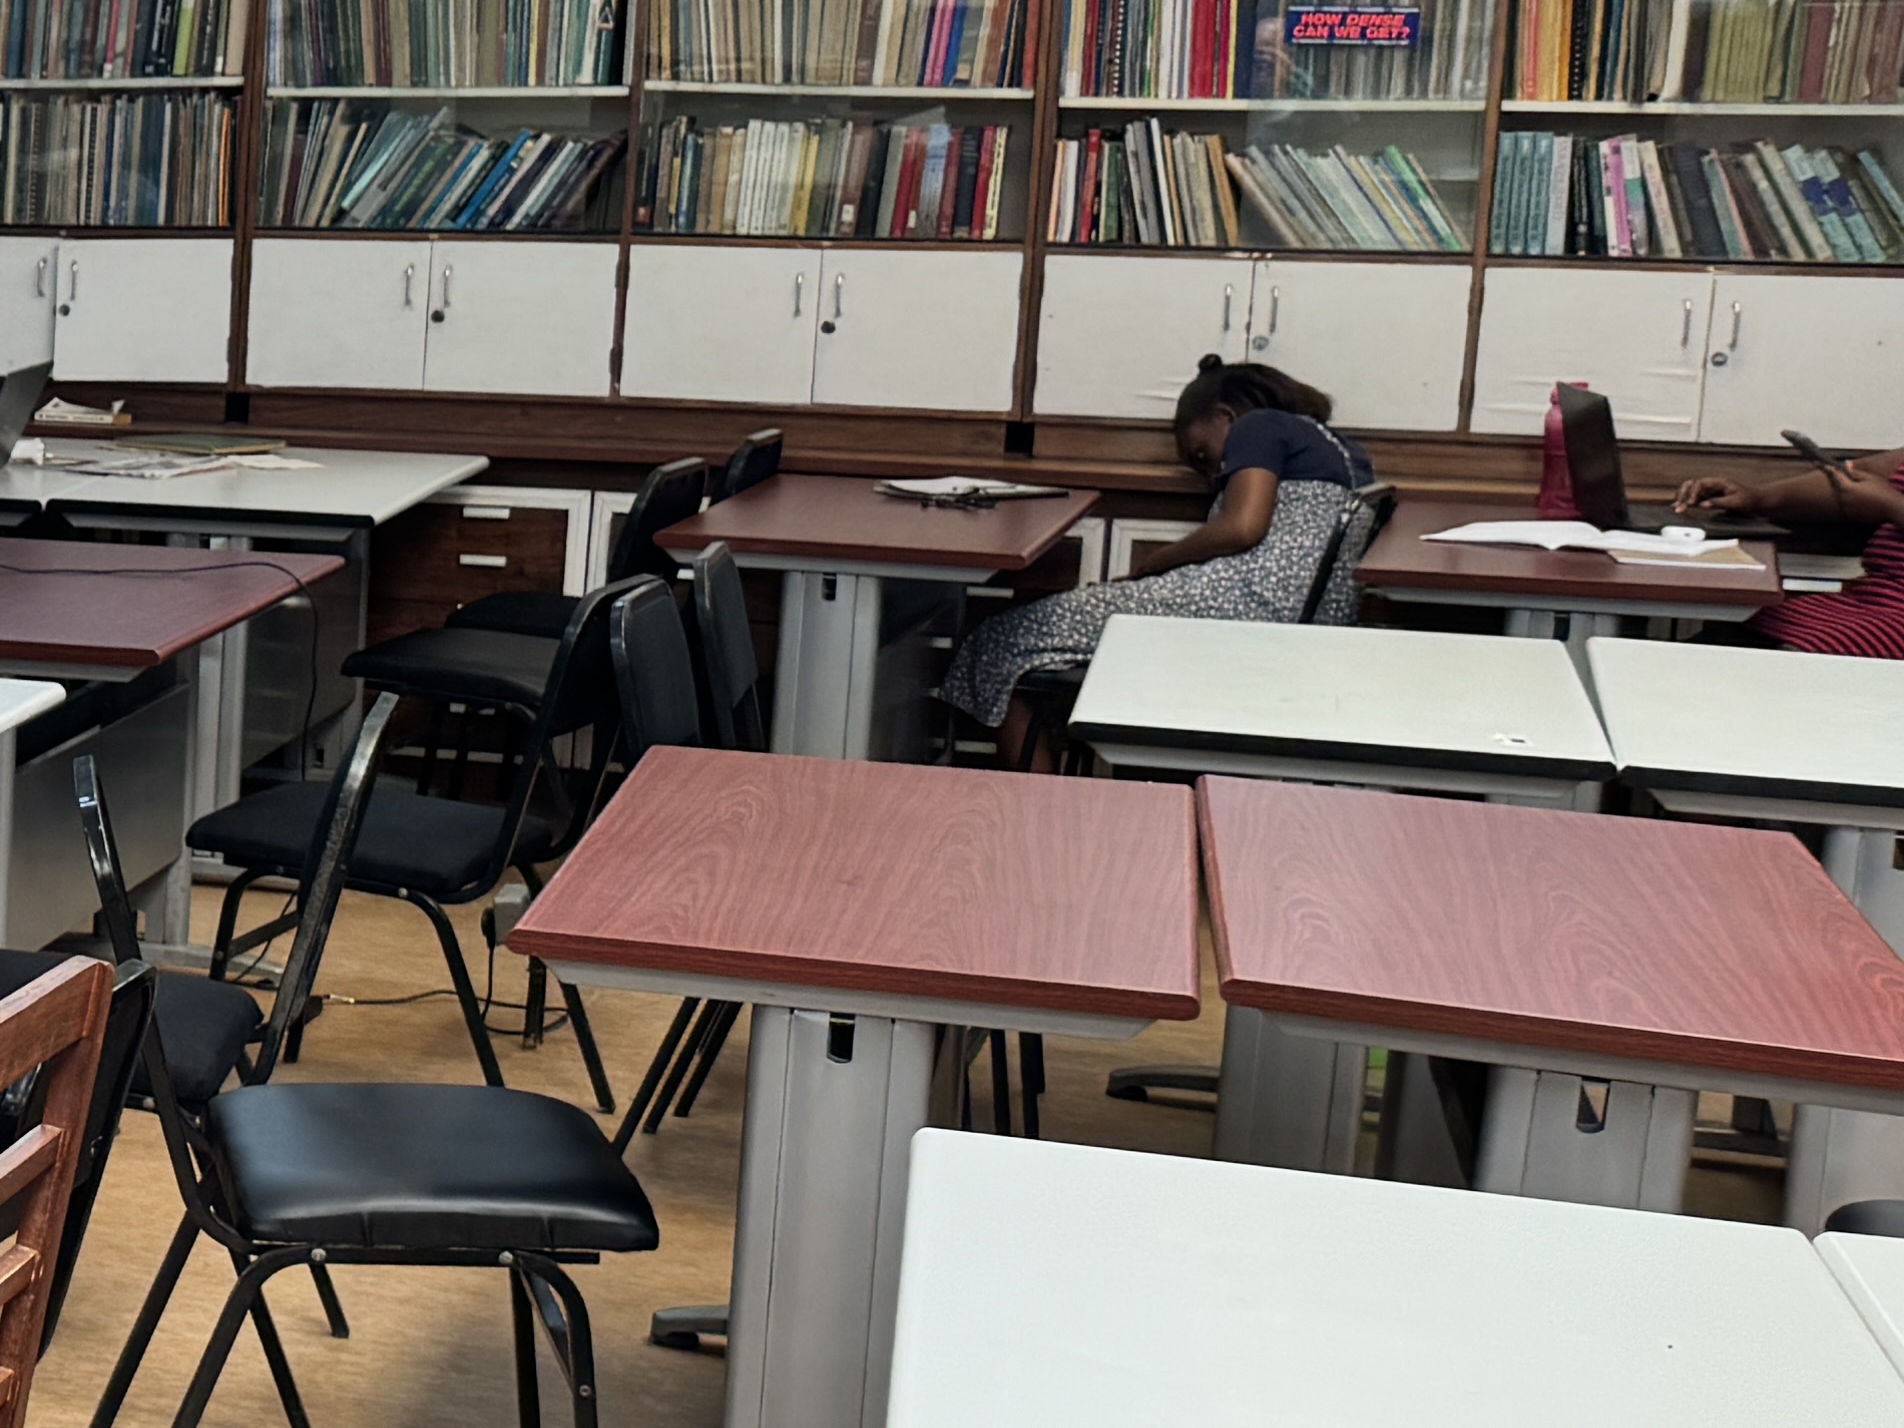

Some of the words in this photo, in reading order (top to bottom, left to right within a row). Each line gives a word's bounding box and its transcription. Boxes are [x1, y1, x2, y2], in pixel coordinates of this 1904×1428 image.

[1300, 13, 1343, 26] HOW
[1346, 14, 1405, 28] DENSE
[1293, 25, 1330, 39] CAN
[1334, 26, 1361, 39] WE
[1365, 27, 1411, 41] GET?
